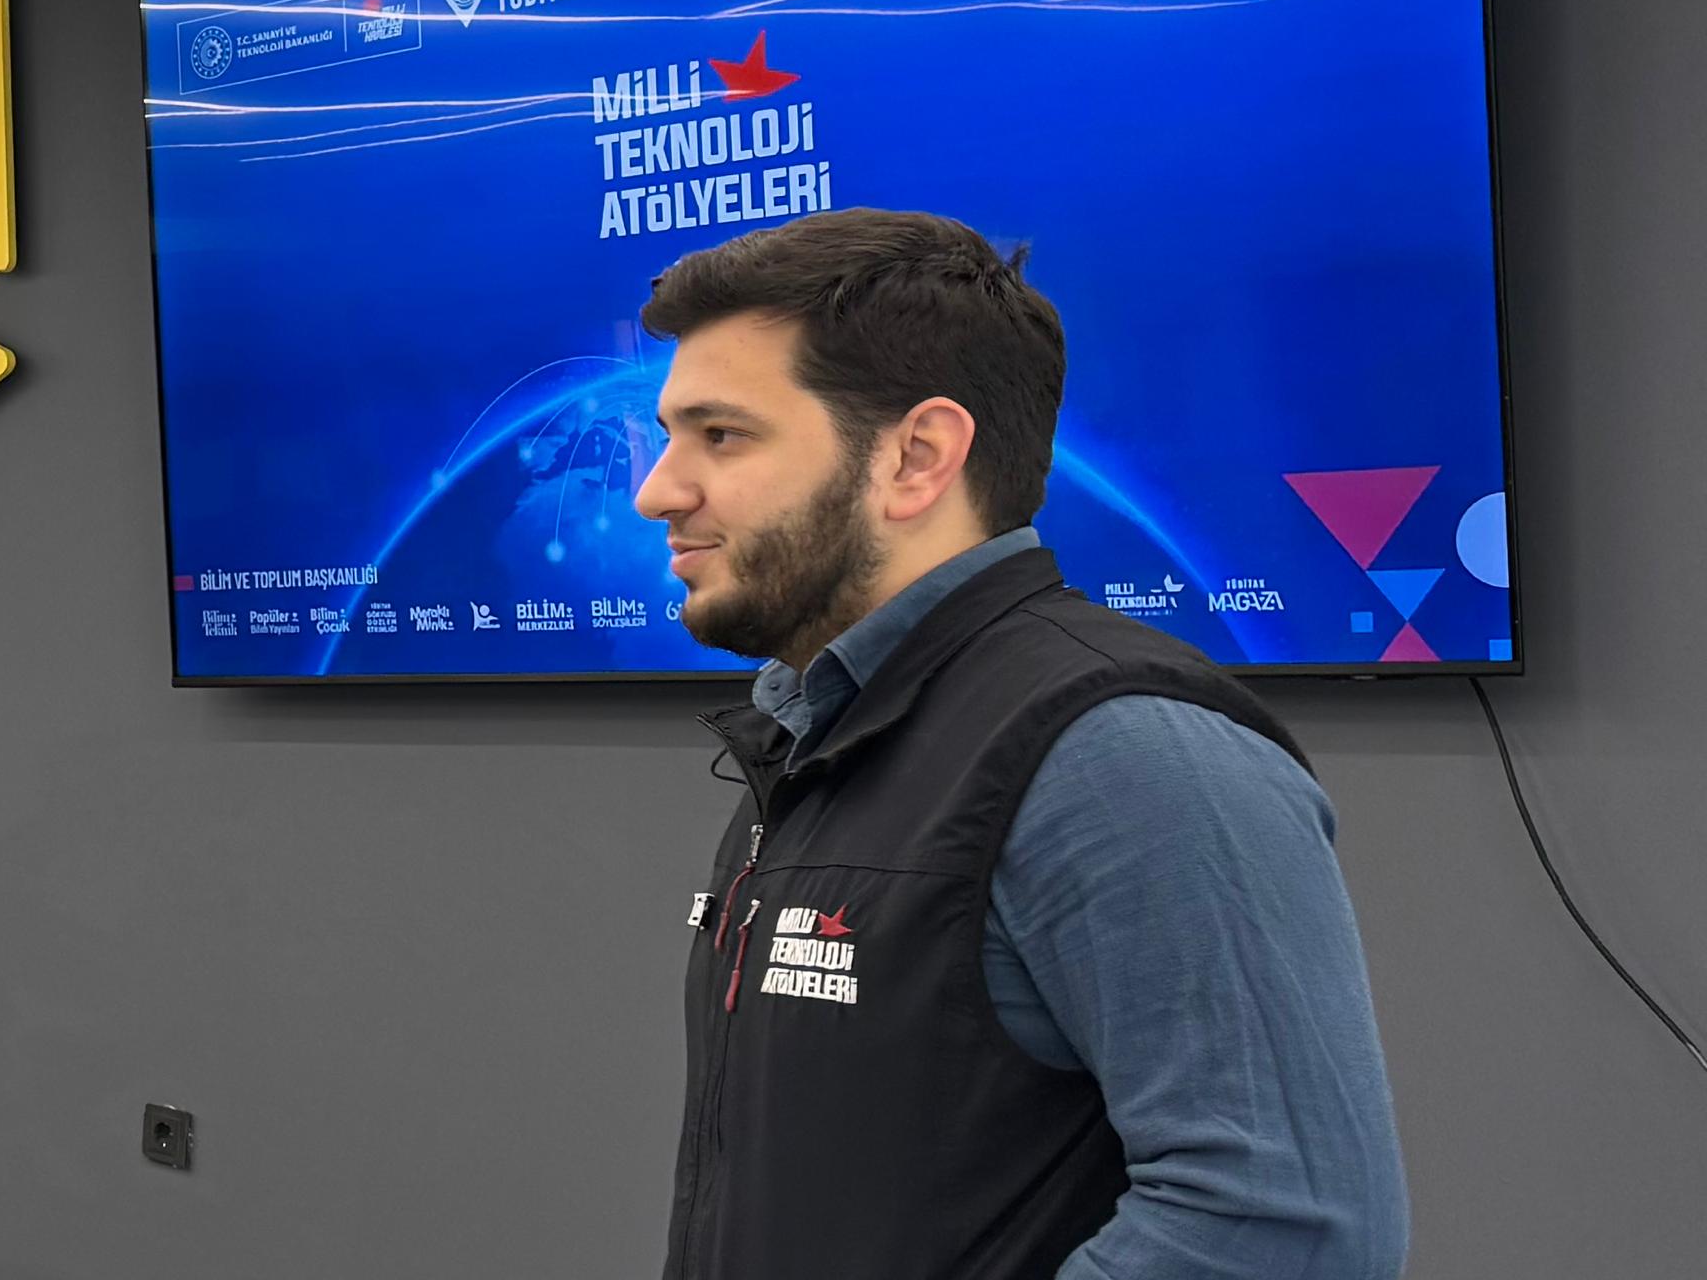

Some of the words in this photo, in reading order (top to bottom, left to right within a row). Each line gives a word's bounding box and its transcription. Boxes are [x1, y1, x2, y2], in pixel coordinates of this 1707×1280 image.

[237, 39, 285, 59] TEKNOLOJİ
[592, 60, 702, 124] MİLLİ
[594, 102, 815, 181] TEKNOLOJİ
[599, 161, 832, 239] ATÖLYELERİ
[200, 569, 232, 591] BİLİM
[234, 572, 251, 590] VE
[252, 569, 302, 589] TOPLUM
[305, 564, 378, 591] BAŞKANLIĞI
[310, 607, 338, 621] Bilim
[516, 599, 565, 619] BİLİM
[591, 596, 637, 616] BİLİM
[249, 609, 289, 626] Popüler
[316, 619, 350, 635] Çocuk
